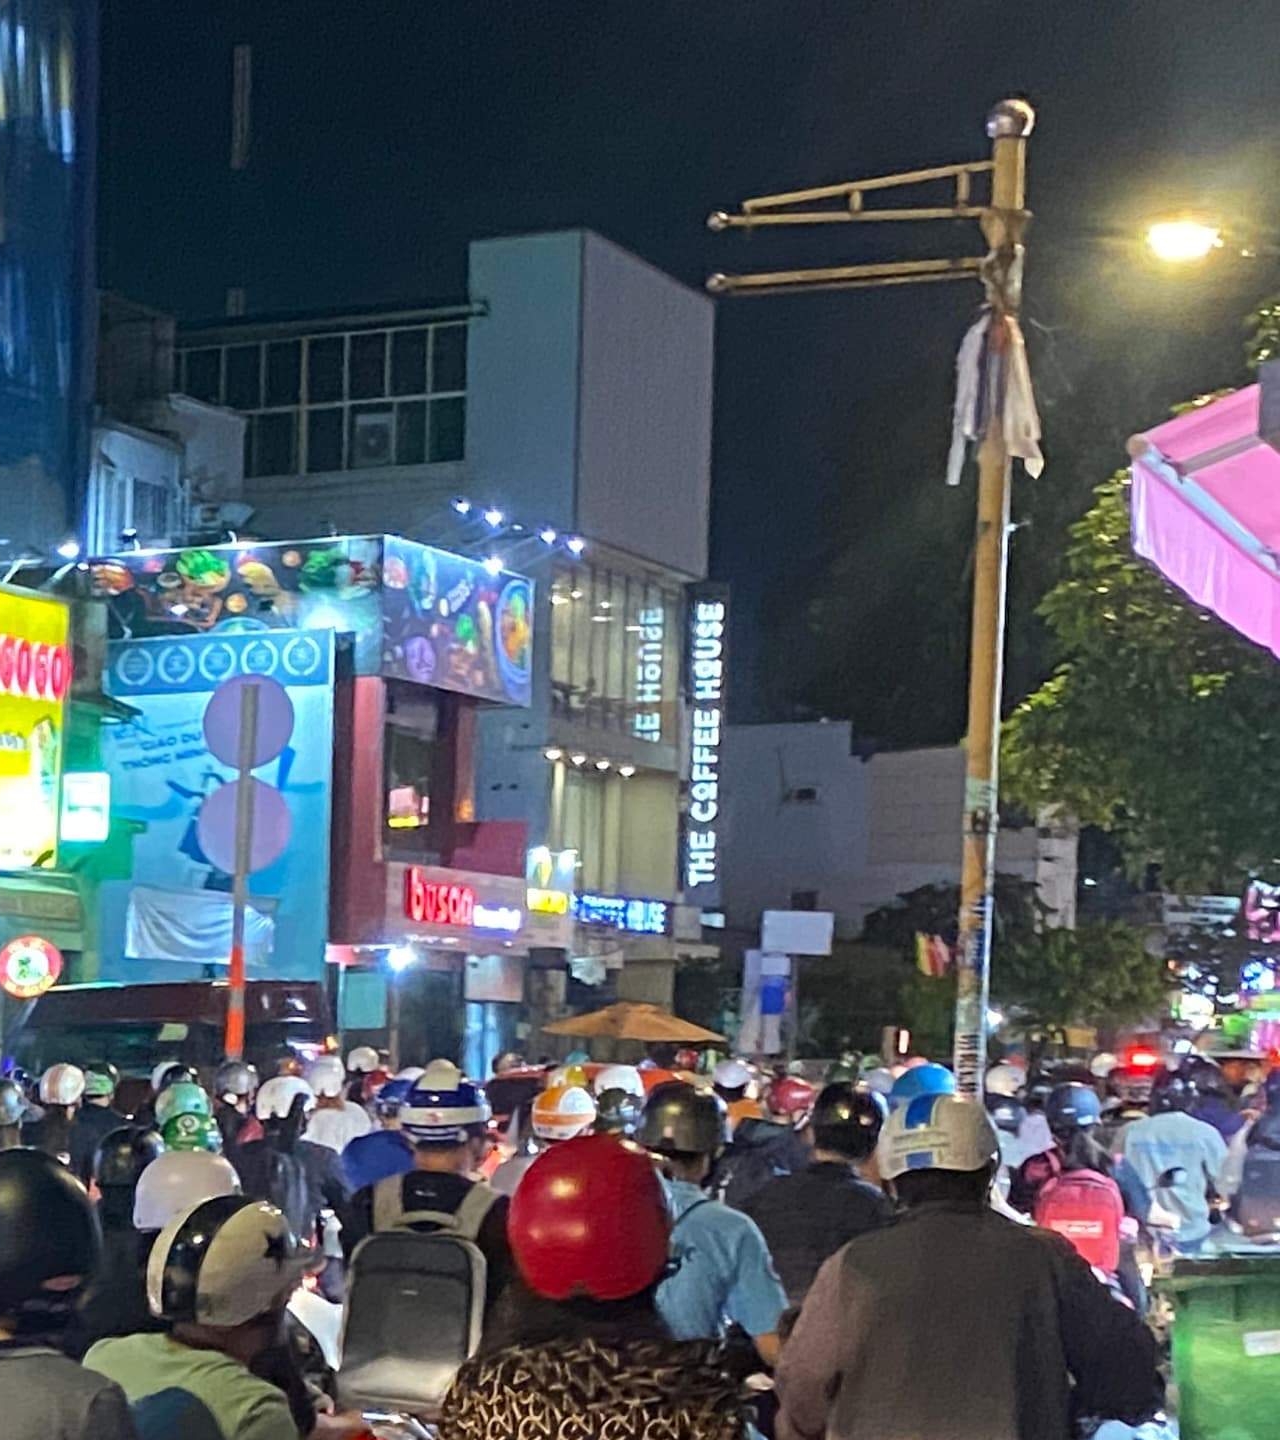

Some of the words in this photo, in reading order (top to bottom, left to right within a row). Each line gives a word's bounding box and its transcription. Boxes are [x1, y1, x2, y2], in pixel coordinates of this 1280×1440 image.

[695, 602, 725, 700] HOUSE
[691, 708, 720, 822] COFFEE
[688, 830, 717, 887] THE
